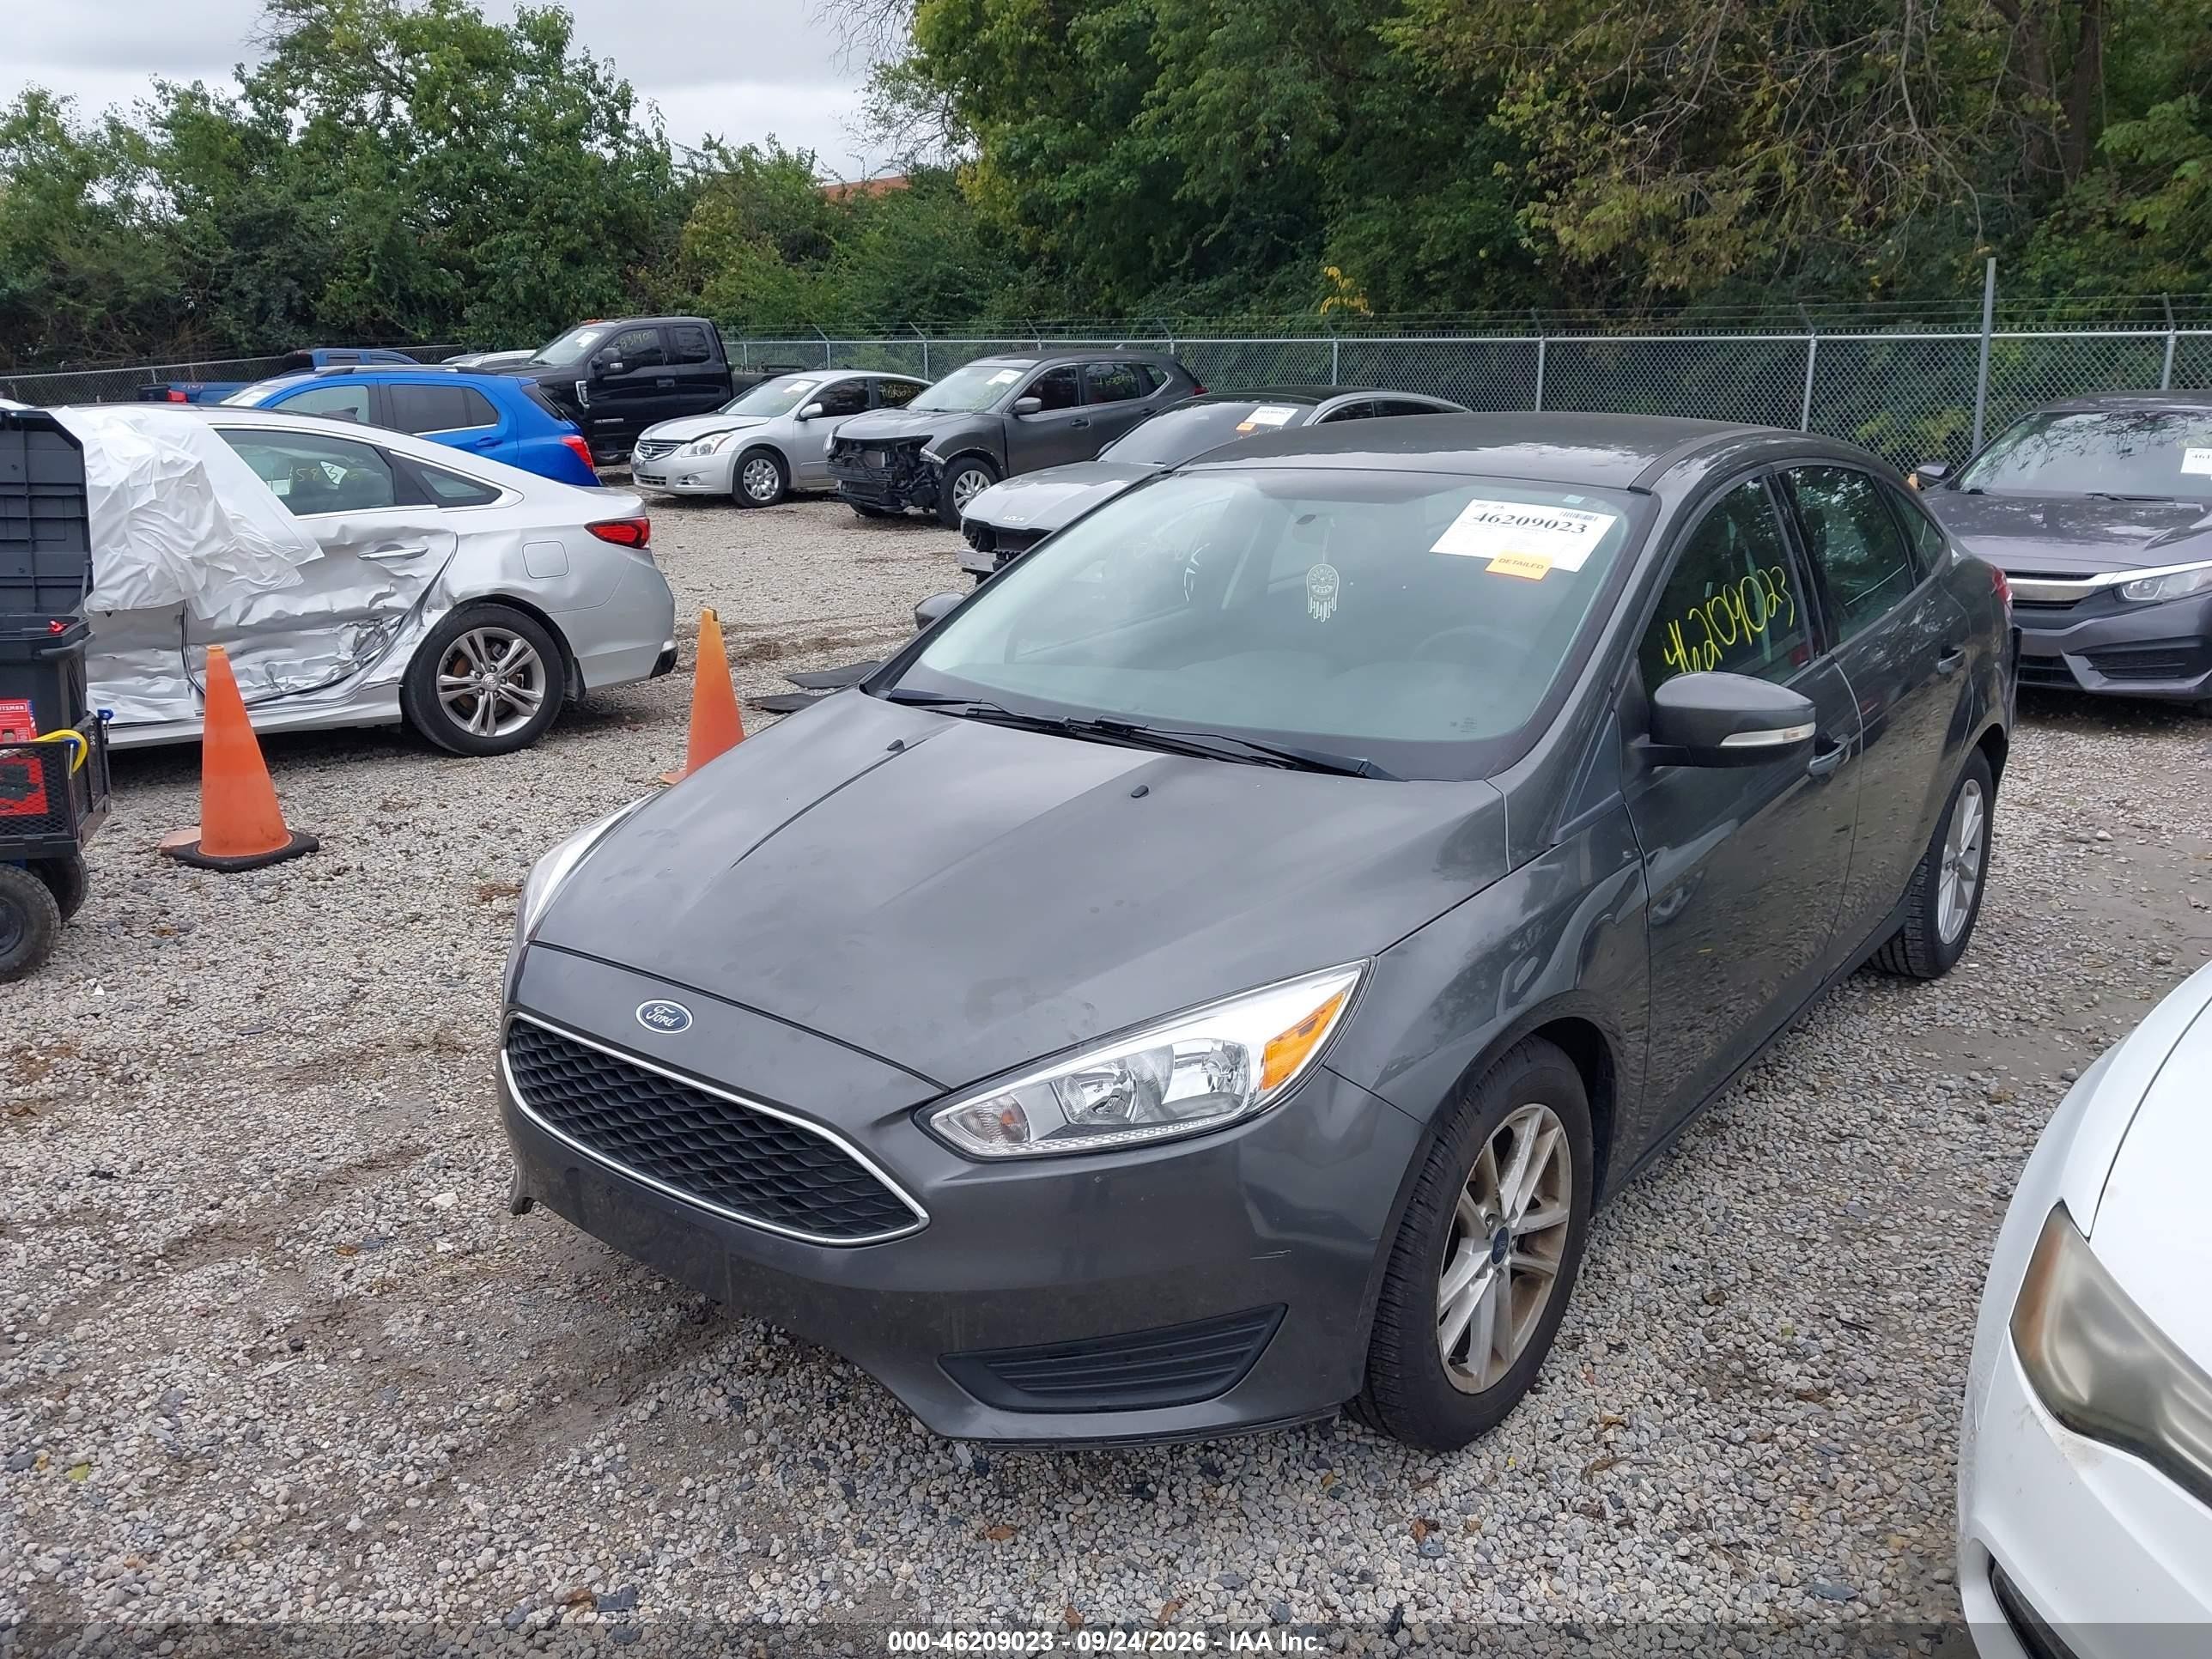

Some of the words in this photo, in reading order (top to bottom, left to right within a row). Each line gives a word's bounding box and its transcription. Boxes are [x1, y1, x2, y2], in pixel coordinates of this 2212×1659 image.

[1473, 512, 1588, 534] 46209023
[1498, 557, 1545, 569] DETAILED
[1663, 566, 1795, 673] 46209023
[646, 1006, 681, 1027] Ford
